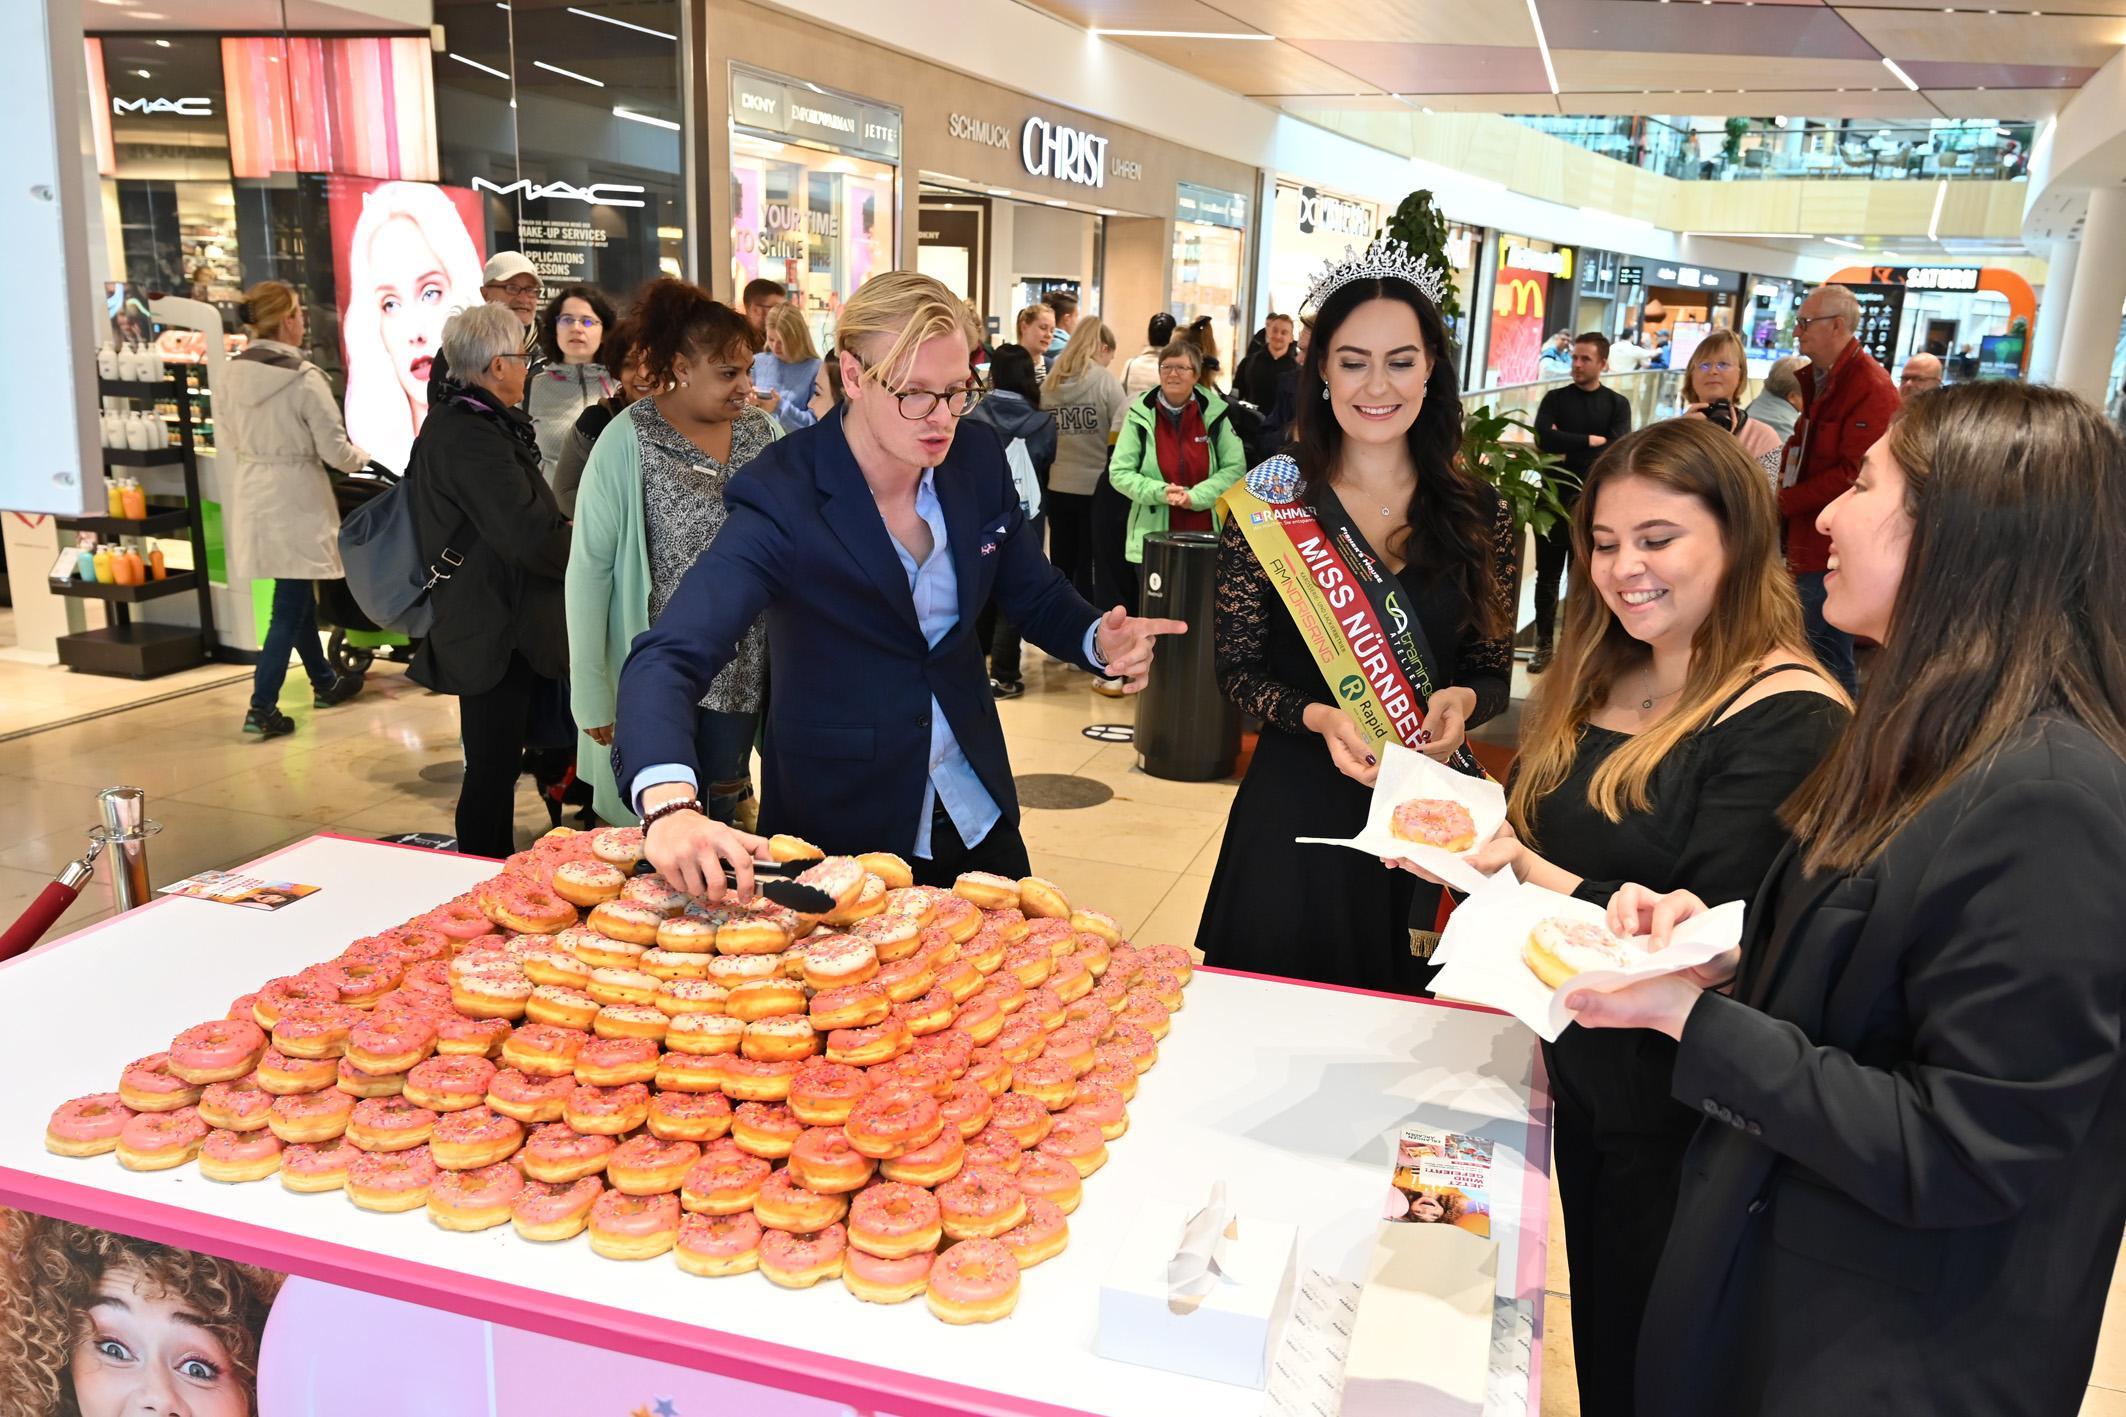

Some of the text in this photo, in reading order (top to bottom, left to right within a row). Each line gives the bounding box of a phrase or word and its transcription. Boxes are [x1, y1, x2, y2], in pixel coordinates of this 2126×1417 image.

[741, 92, 776, 114] DKNY
[949, 113, 1010, 150] SCHMUCK
[1022, 116, 1109, 189] CHRIST
[1111, 157, 1142, 181] UHREN
[761, 203, 801, 233] YOUR
[519, 225, 607, 242] MAKE-UP SERVICES
[758, 231, 804, 260] SHINE
[536, 264, 570, 276] ESSONS
[1905, 268, 1978, 290] SATURN
[1297, 536, 1355, 609] MISS
[1362, 558, 1383, 584] HOUSE
[1389, 632, 1421, 691] ATELIER
[1359, 699, 1388, 739] Rapid
